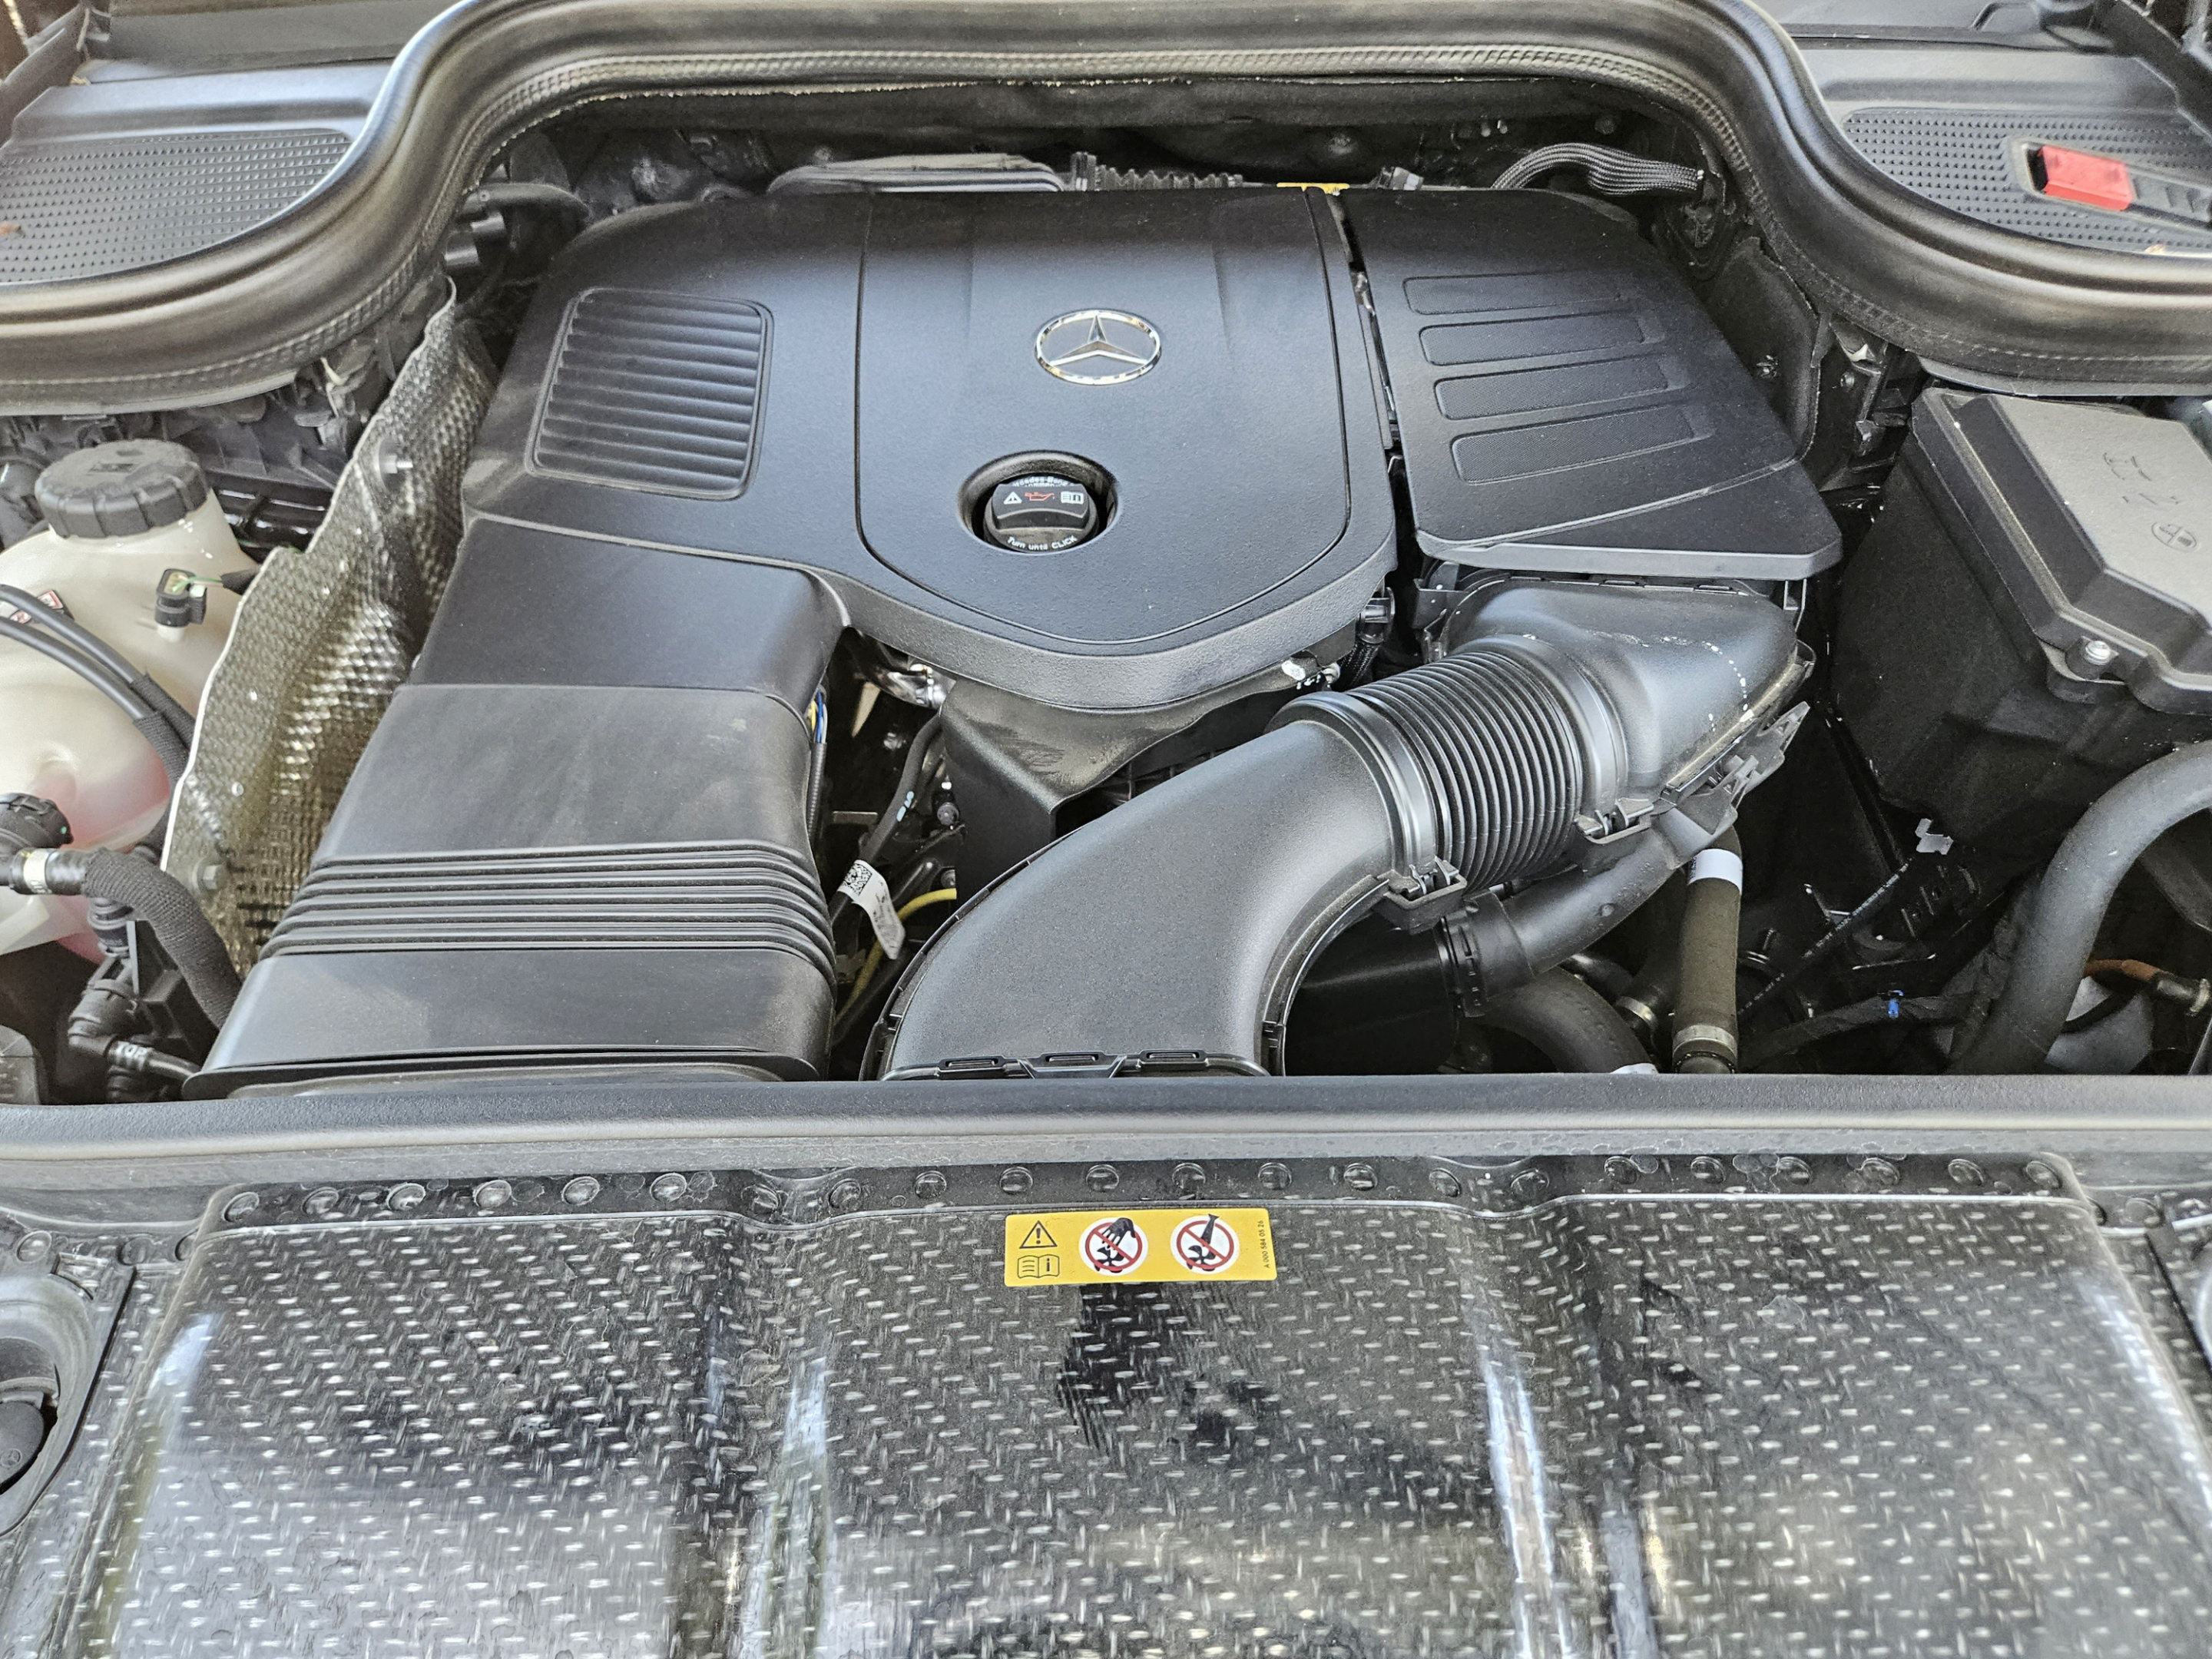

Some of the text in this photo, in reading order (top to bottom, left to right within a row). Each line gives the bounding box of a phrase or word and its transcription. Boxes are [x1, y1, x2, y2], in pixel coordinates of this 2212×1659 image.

[1008, 536, 1025, 548] Turn
[1051, 535, 1078, 549] CLICK
[1257, 1220, 1264, 1228] 26
[1258, 1229, 1266, 1237] 05
